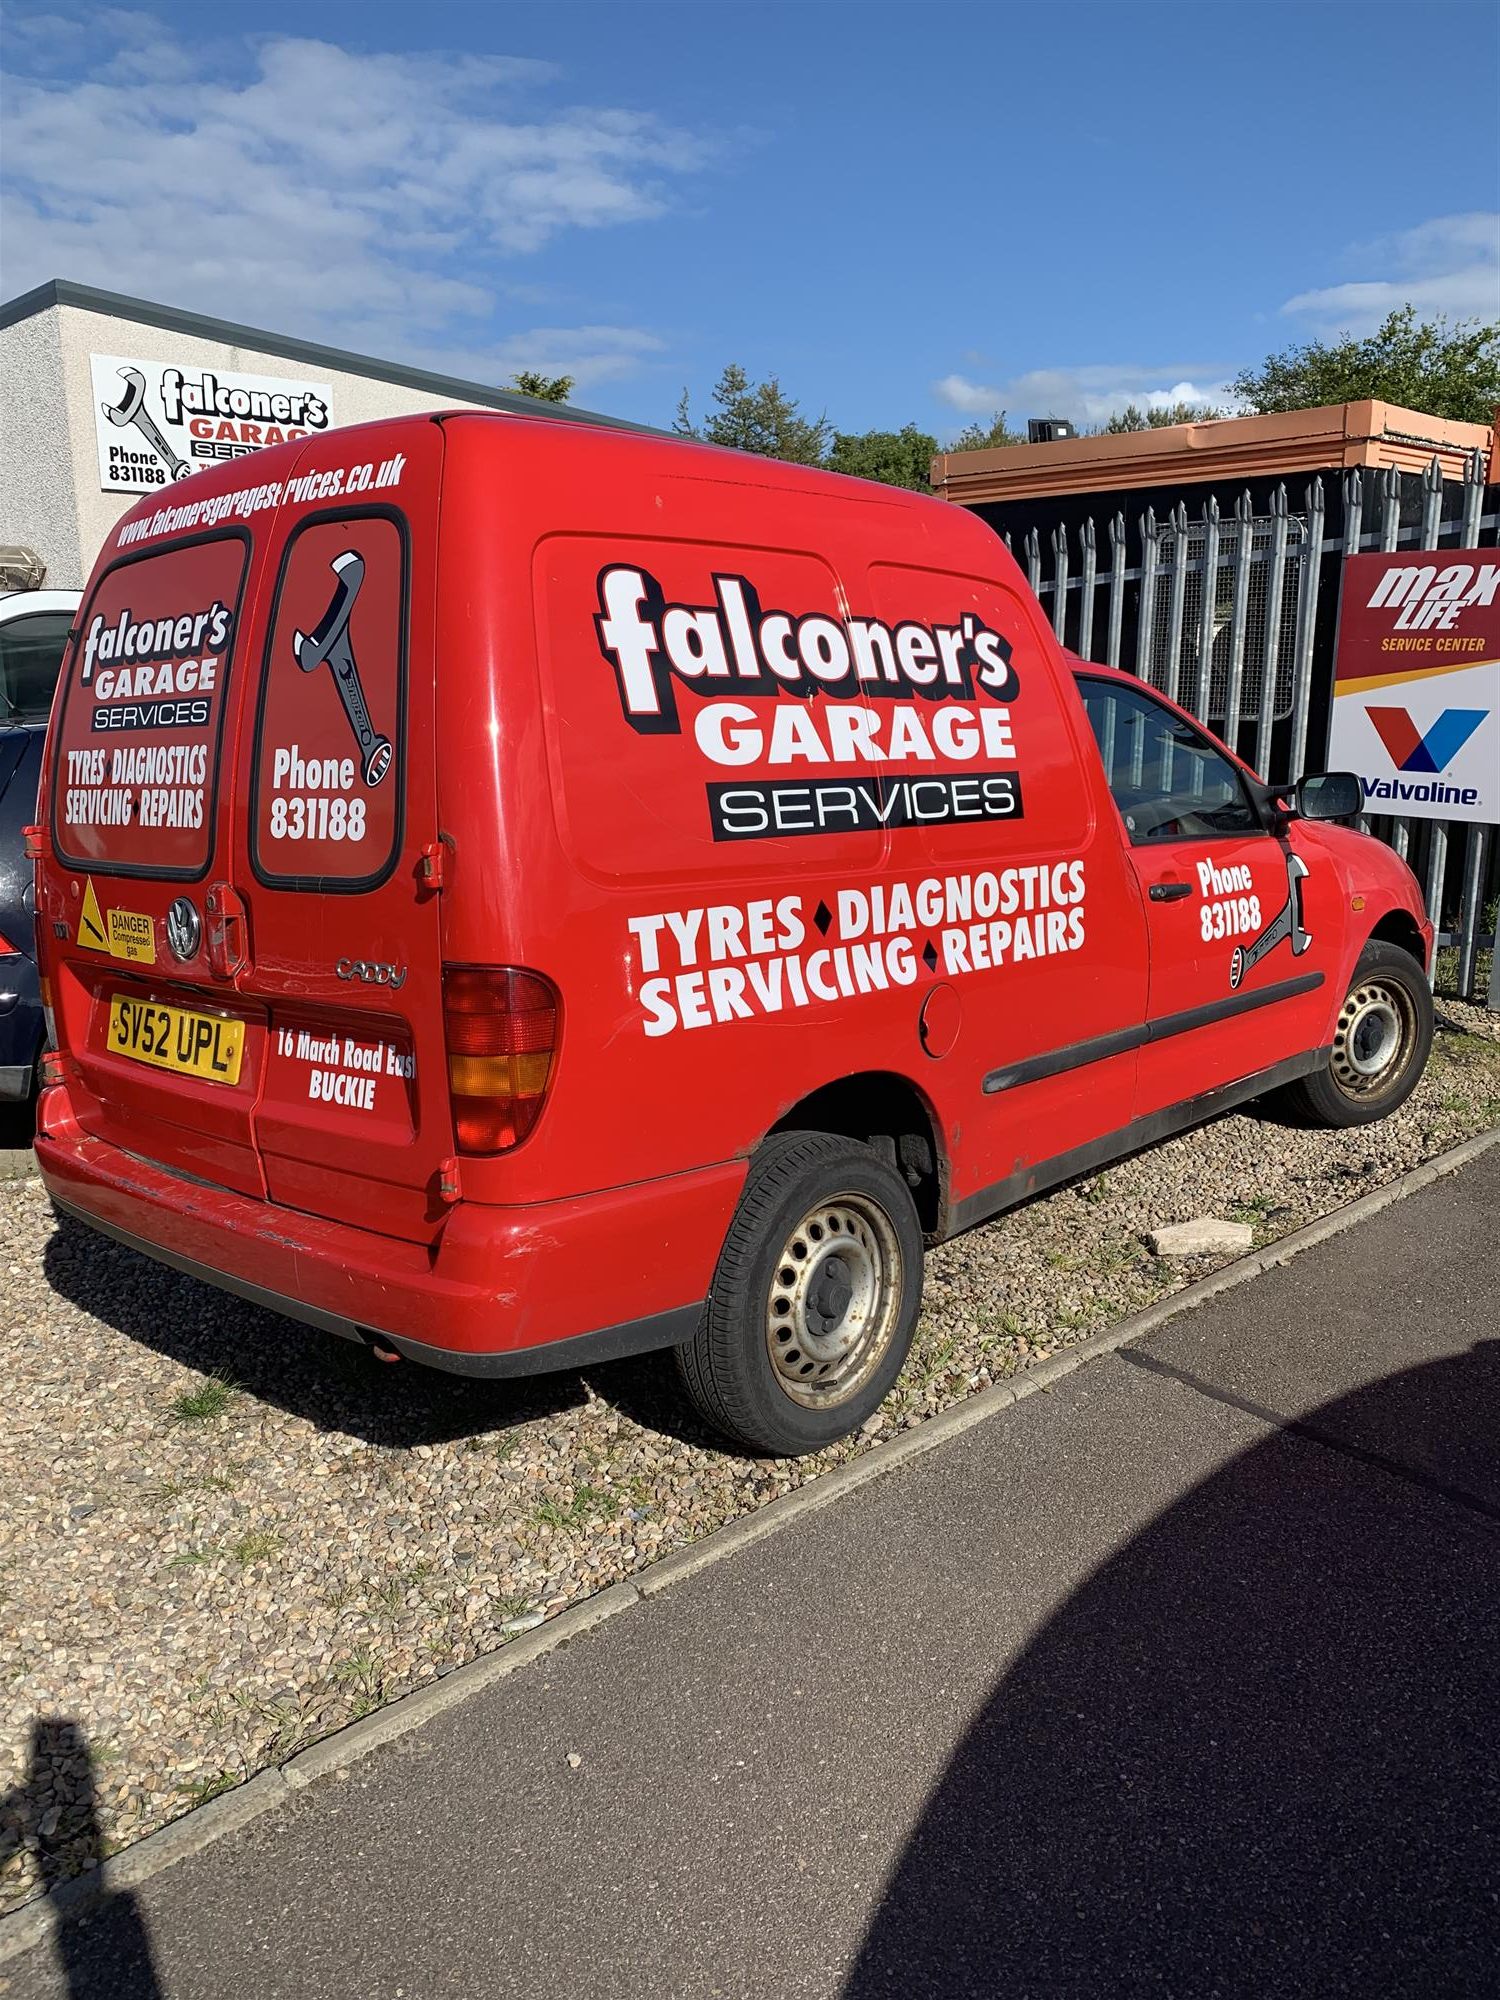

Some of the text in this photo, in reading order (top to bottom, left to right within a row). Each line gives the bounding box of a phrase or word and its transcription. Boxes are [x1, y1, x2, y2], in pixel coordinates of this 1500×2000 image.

[160, 368, 329, 428] falconer's
[109, 446, 158, 465] Phone
[109, 466, 166, 485] 831188
[1393, 600, 1470, 630] LIFE
[82, 602, 231, 683] falconer's
[595, 564, 1016, 725] falconer's
[1381, 637, 1486, 651] SERVICE CENTER
[95, 658, 218, 700] GARAGE
[95, 701, 208, 729] SERVICES
[694, 703, 1016, 766] GARAGE
[68, 745, 207, 785] TYRES DIAGNOSTICS
[273, 745, 354, 789] Phone
[66, 789, 204, 829] SERVICING REPAIRS
[719, 778, 1015, 833] SERVICES
[1362, 777, 1478, 806] Valvoline
[270, 798, 366, 841] 831188
[1196, 857, 1253, 897] Phone
[112, 913, 150, 934] DANGER
[628, 860, 1085, 973] TYRES DIAGNOSTICS
[1200, 895, 1262, 942] 831188
[113, 930, 151, 947] Compressed
[126, 946, 138, 957] gas
[638, 906, 1085, 1037] SERVICING REPAIRS
[118, 1002, 228, 1072] SV52 UPL
[278, 1027, 294, 1058] 16
[296, 1030, 340, 1065] March
[343, 1038, 384, 1073] Road
[308, 1069, 376, 1110] BUCKIE
